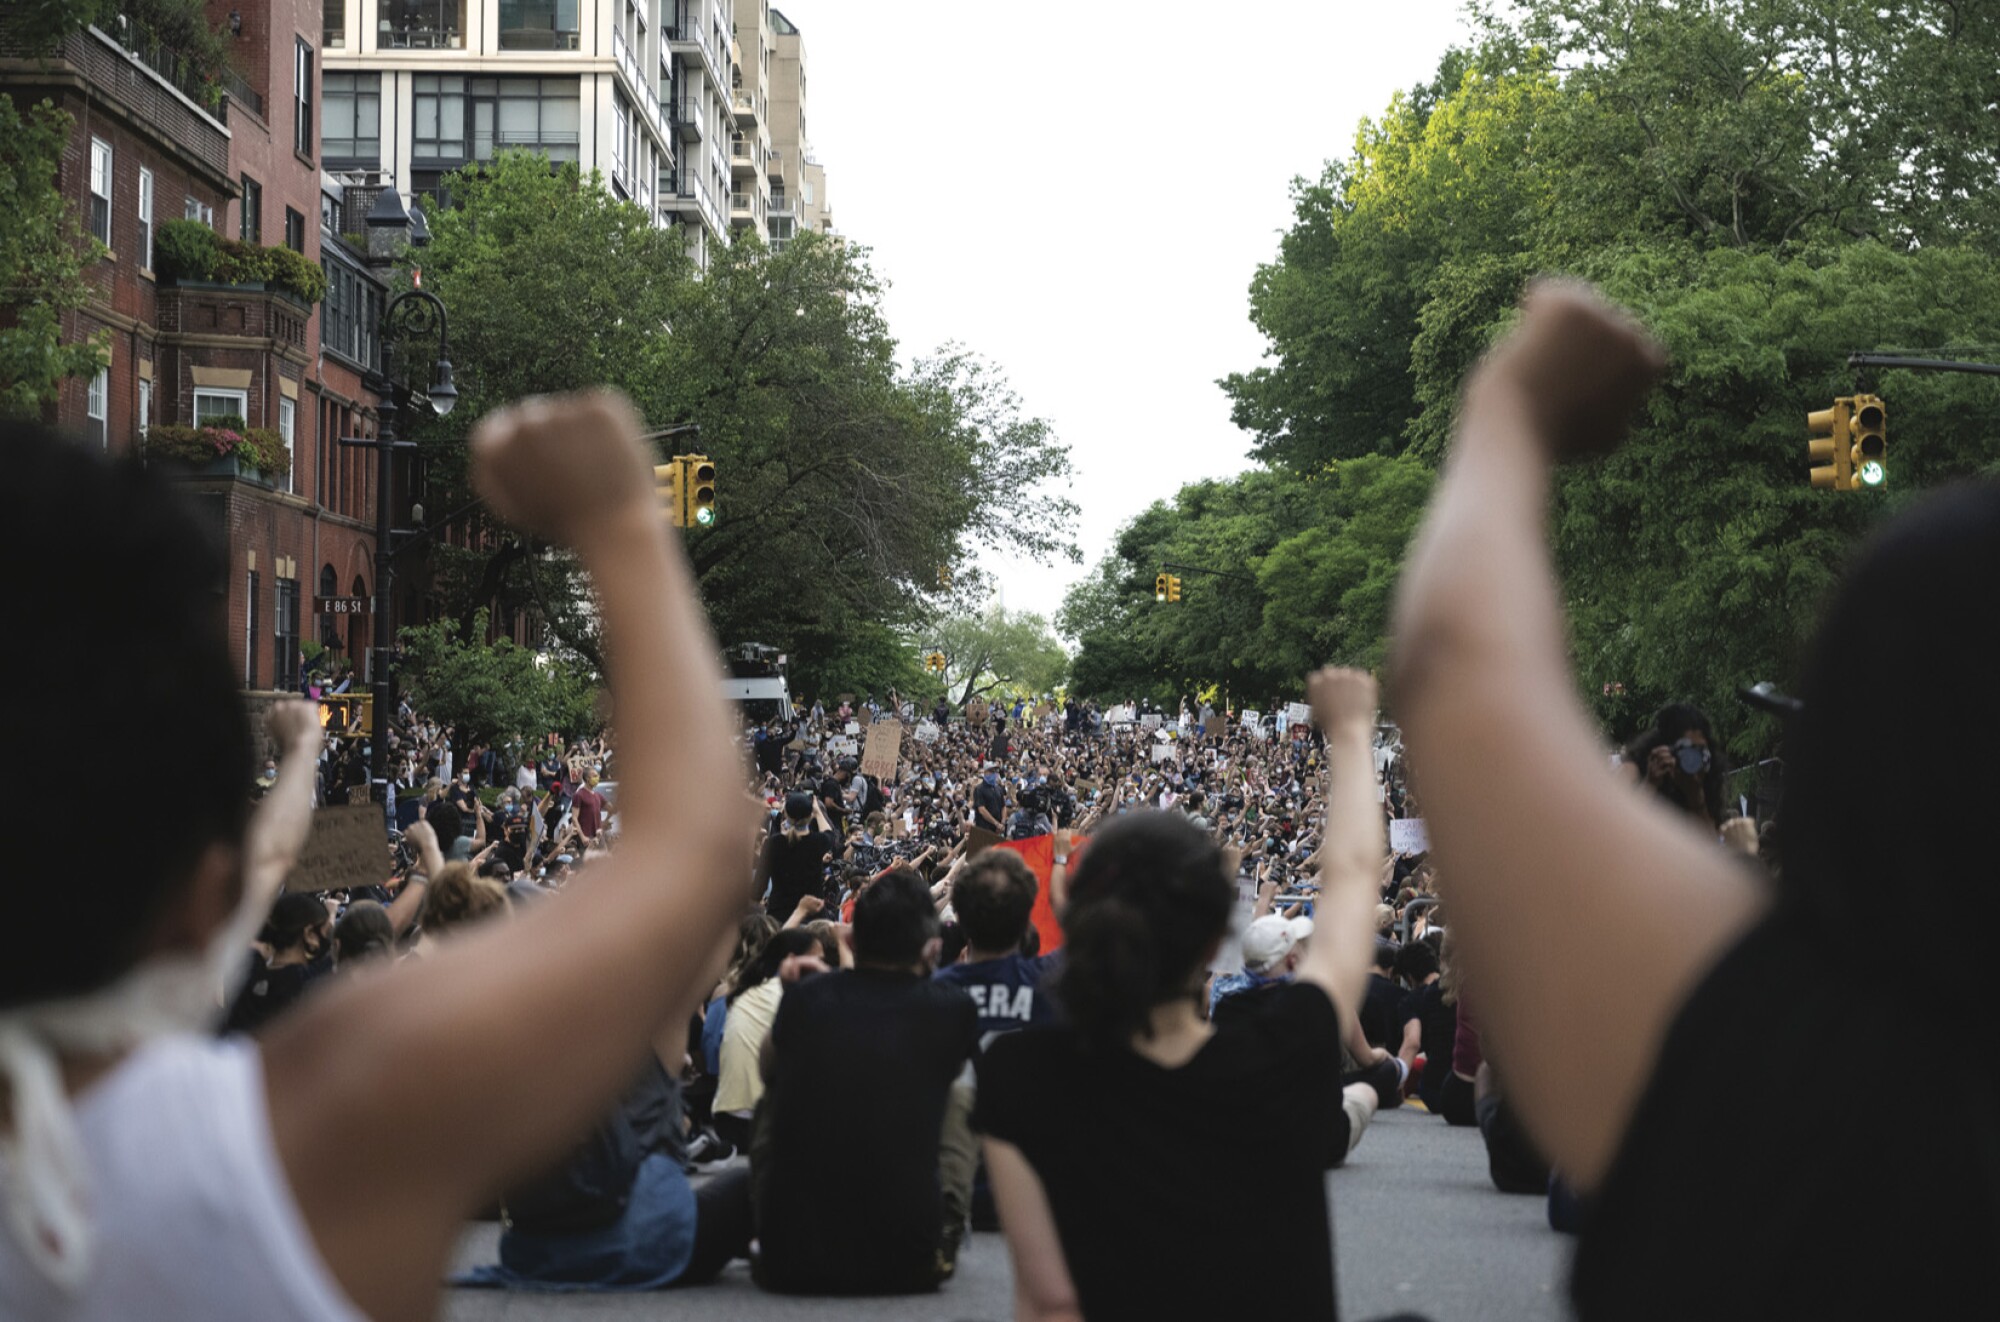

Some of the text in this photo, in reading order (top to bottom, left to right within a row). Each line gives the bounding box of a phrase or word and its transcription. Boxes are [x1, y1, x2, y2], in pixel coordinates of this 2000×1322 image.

[325, 600, 361, 613] E 86 St
[967, 984, 1034, 1022] ERA
